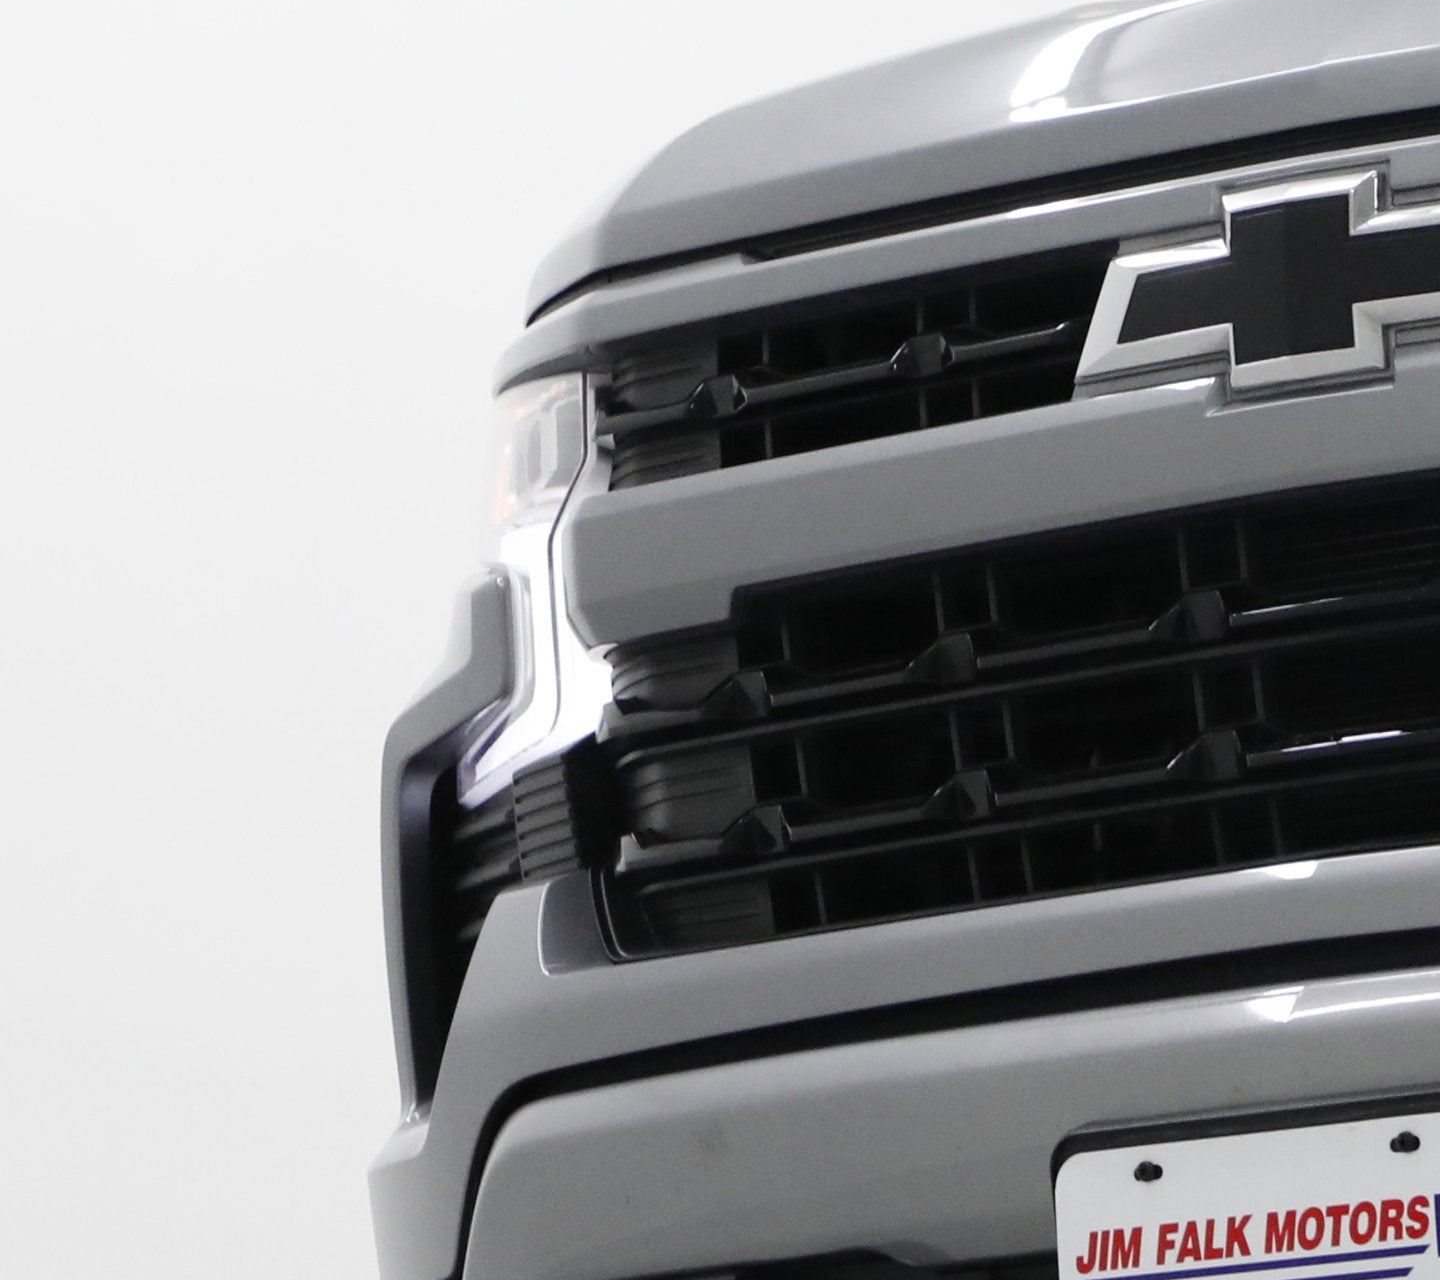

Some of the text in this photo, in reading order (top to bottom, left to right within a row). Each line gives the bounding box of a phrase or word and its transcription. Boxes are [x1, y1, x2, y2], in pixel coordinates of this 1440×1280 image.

[1076, 1195, 1430, 1274] JIM FALK MOTORS
